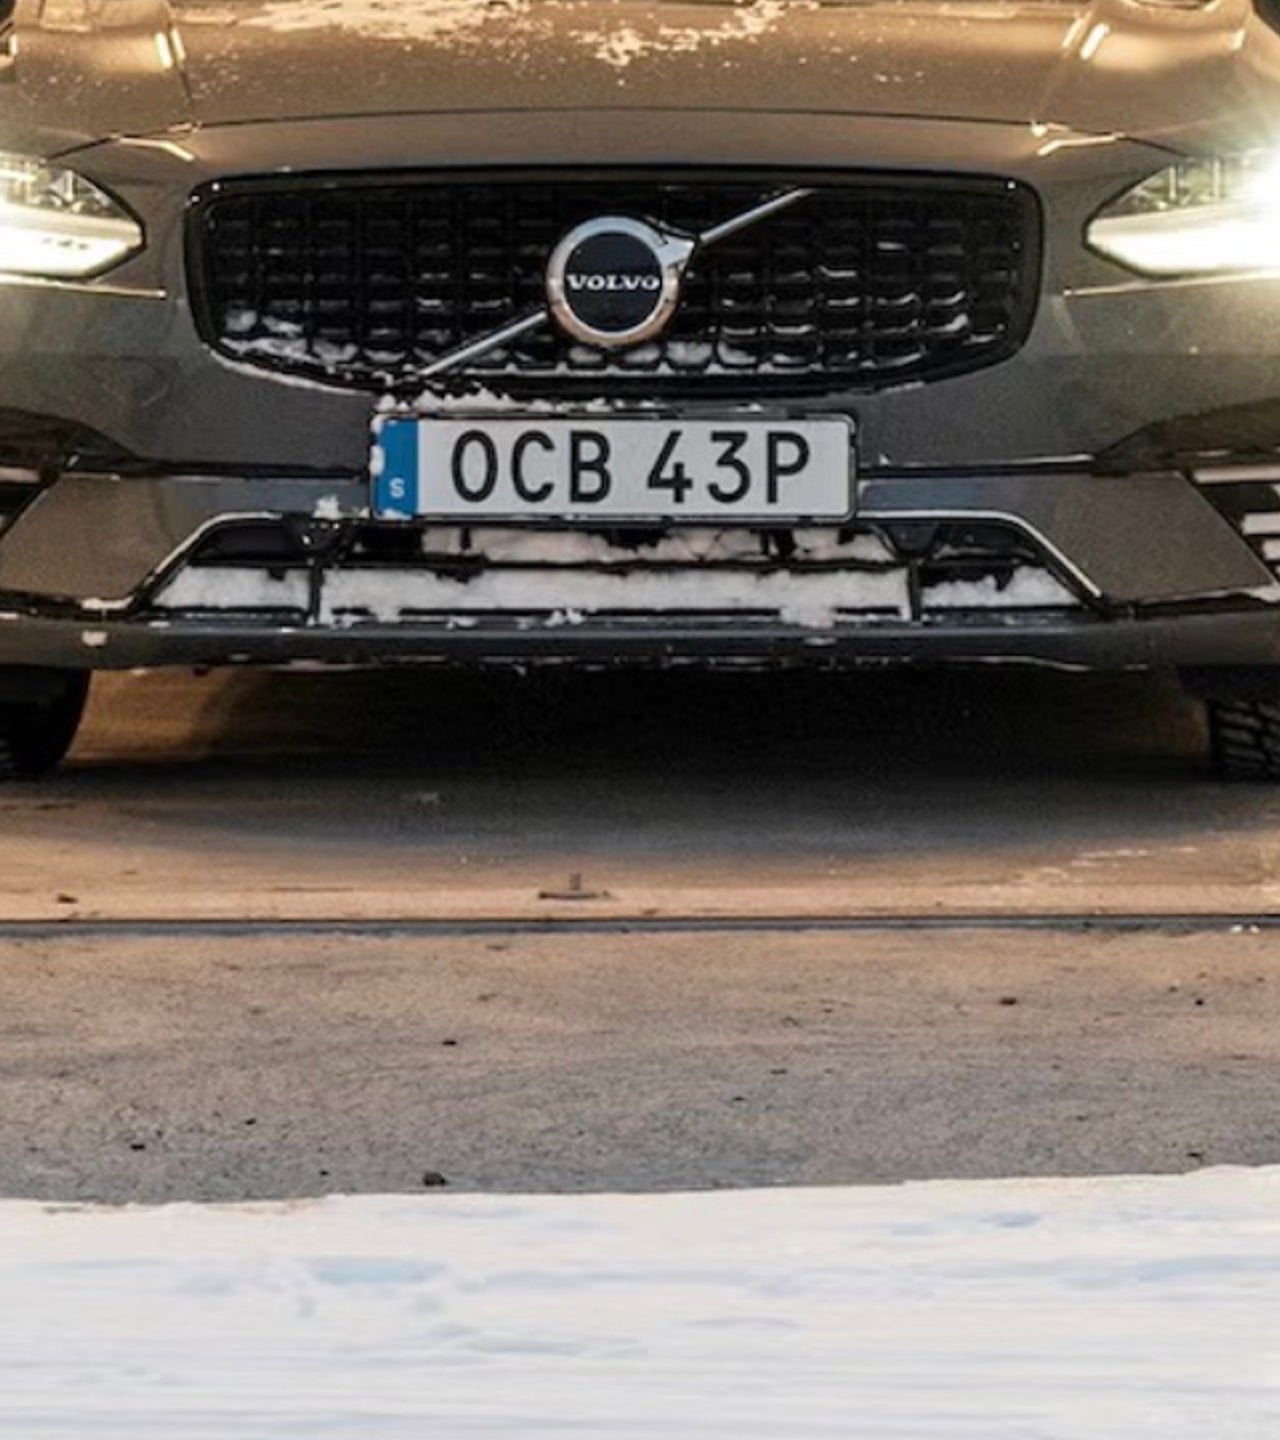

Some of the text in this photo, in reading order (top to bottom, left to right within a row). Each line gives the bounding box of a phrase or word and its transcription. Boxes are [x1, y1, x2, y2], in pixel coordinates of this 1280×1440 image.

[566, 274, 661, 290] VOLVO
[450, 428, 812, 505] OCB 43P
[388, 477, 406, 499] S
